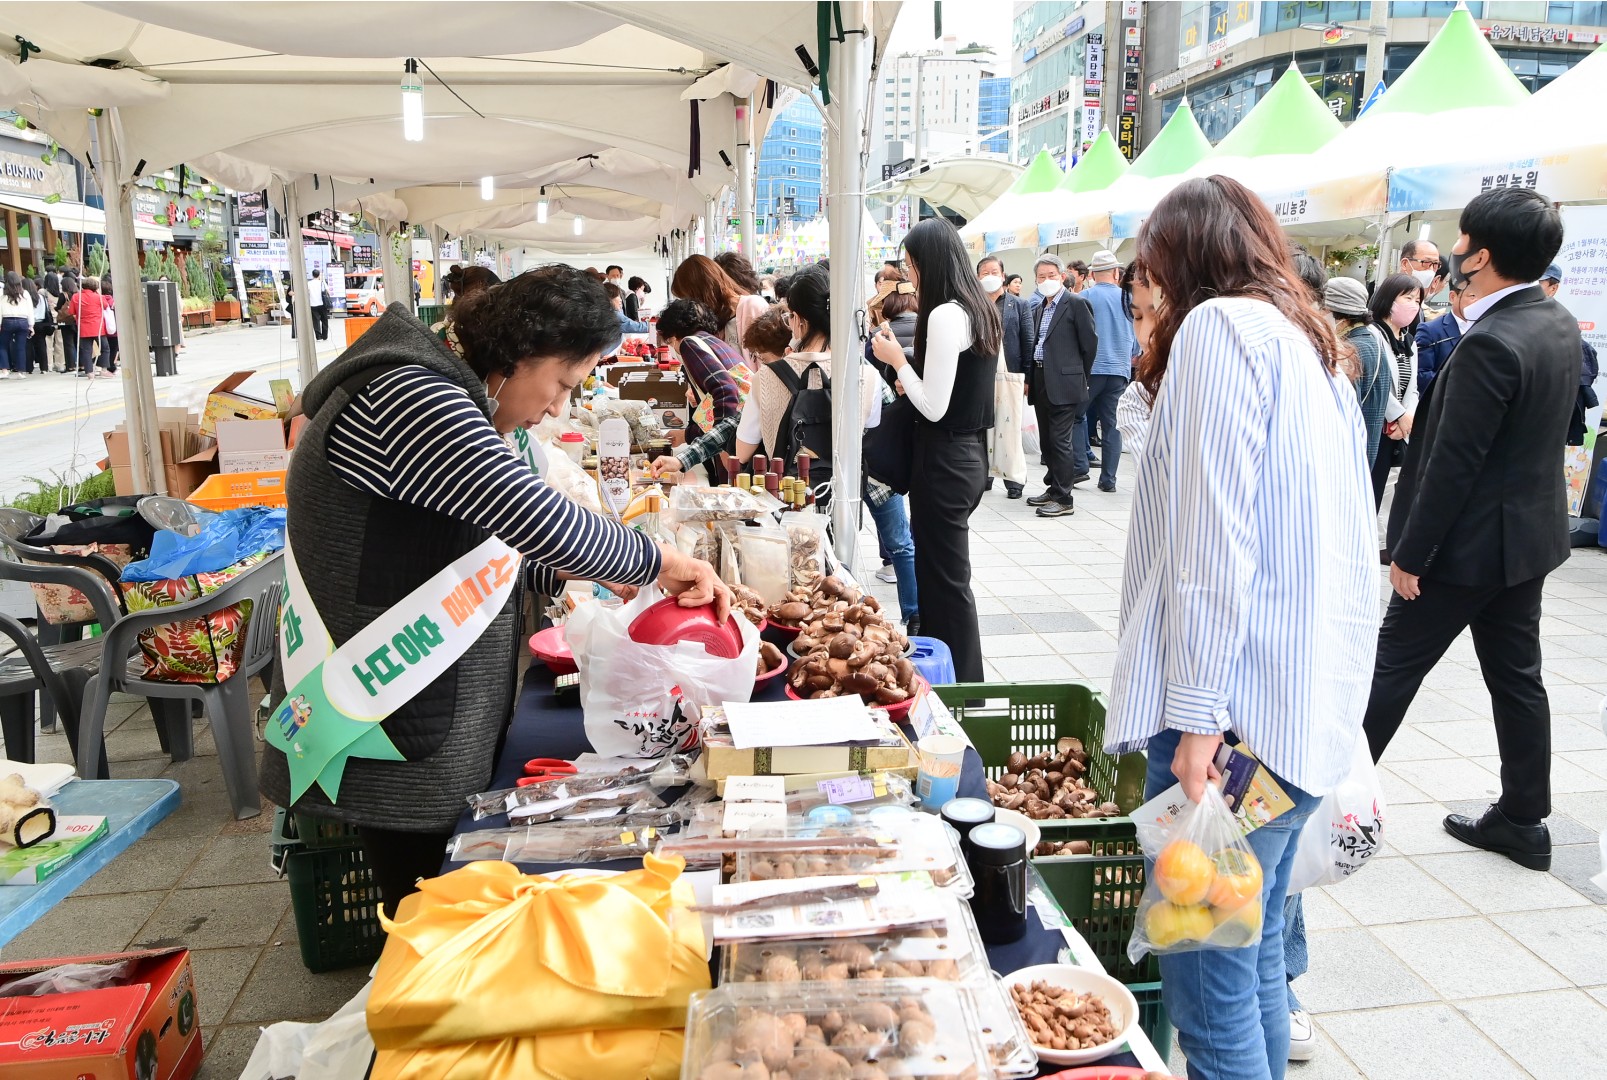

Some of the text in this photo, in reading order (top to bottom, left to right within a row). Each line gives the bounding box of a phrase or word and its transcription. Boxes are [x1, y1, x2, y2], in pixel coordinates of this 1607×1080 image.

[1128, 7, 1137, 15] 5F
[1489, 24, 1570, 44] 유가네닭갈비
[1090, 45, 1098, 79] 노래타운
[1120, 116, 1134, 158] 궁타이
[5, 162, 45, 181] BUSANO
[352, 613, 445, 697] 홍보
